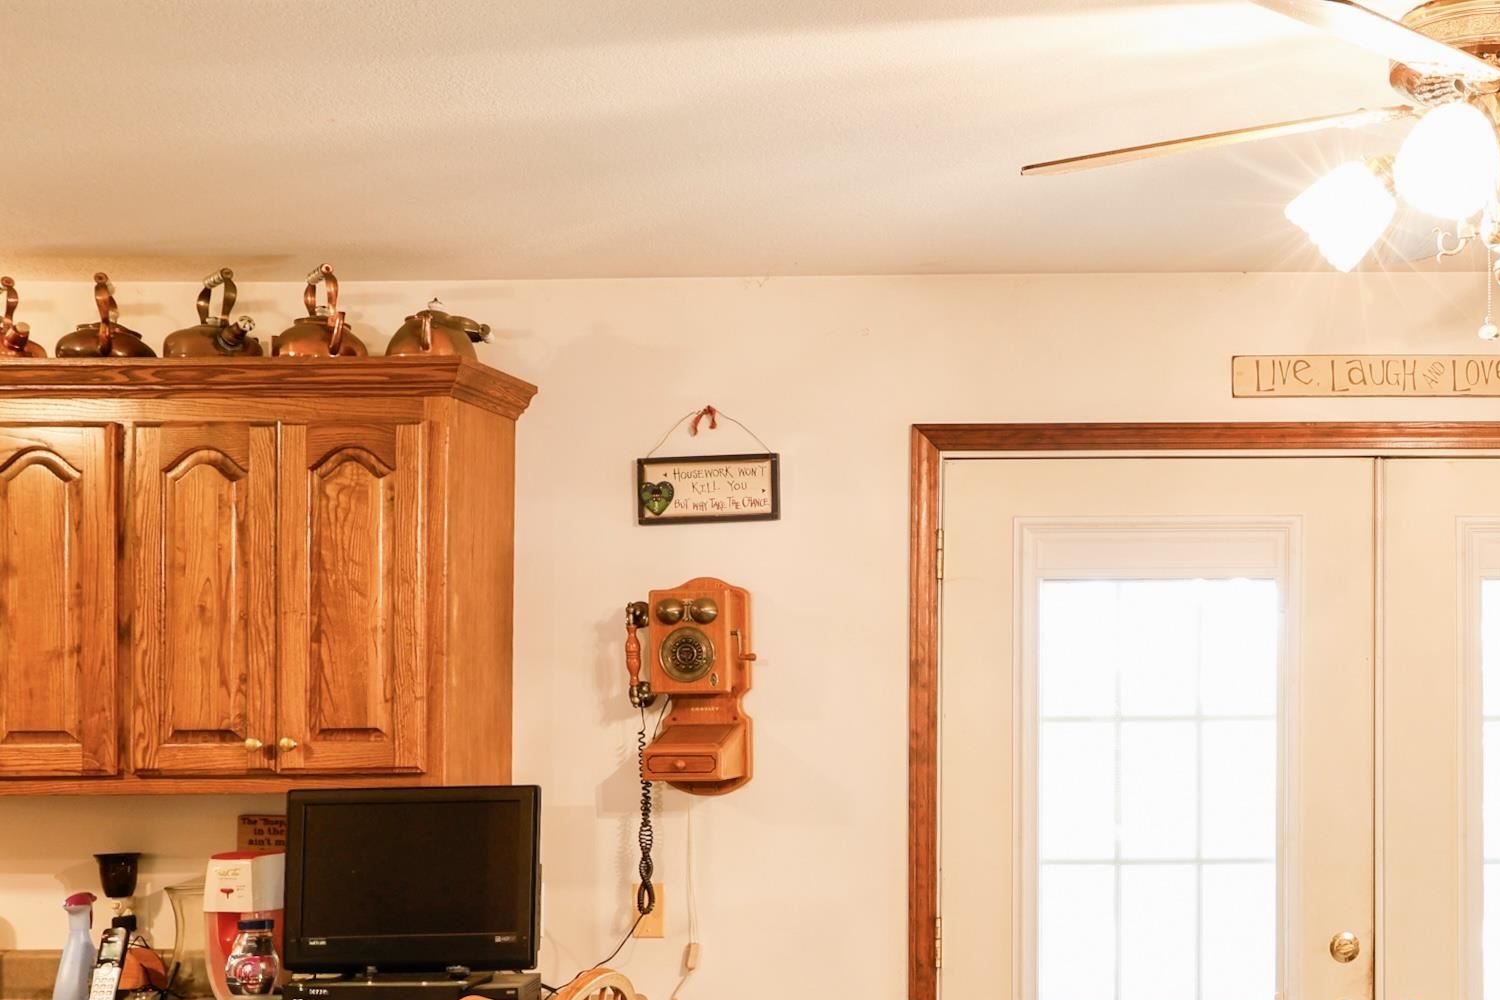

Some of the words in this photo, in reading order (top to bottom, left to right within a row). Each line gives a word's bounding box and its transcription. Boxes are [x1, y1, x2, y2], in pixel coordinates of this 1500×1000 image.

[1422, 361, 1446, 389] AND
[673, 467, 734, 482] HOUSEWORK
[692, 480, 720, 495] KILL
[727, 480, 748, 492] YOU
[254, 828, 264, 836] in
[268, 828, 285, 836] the
